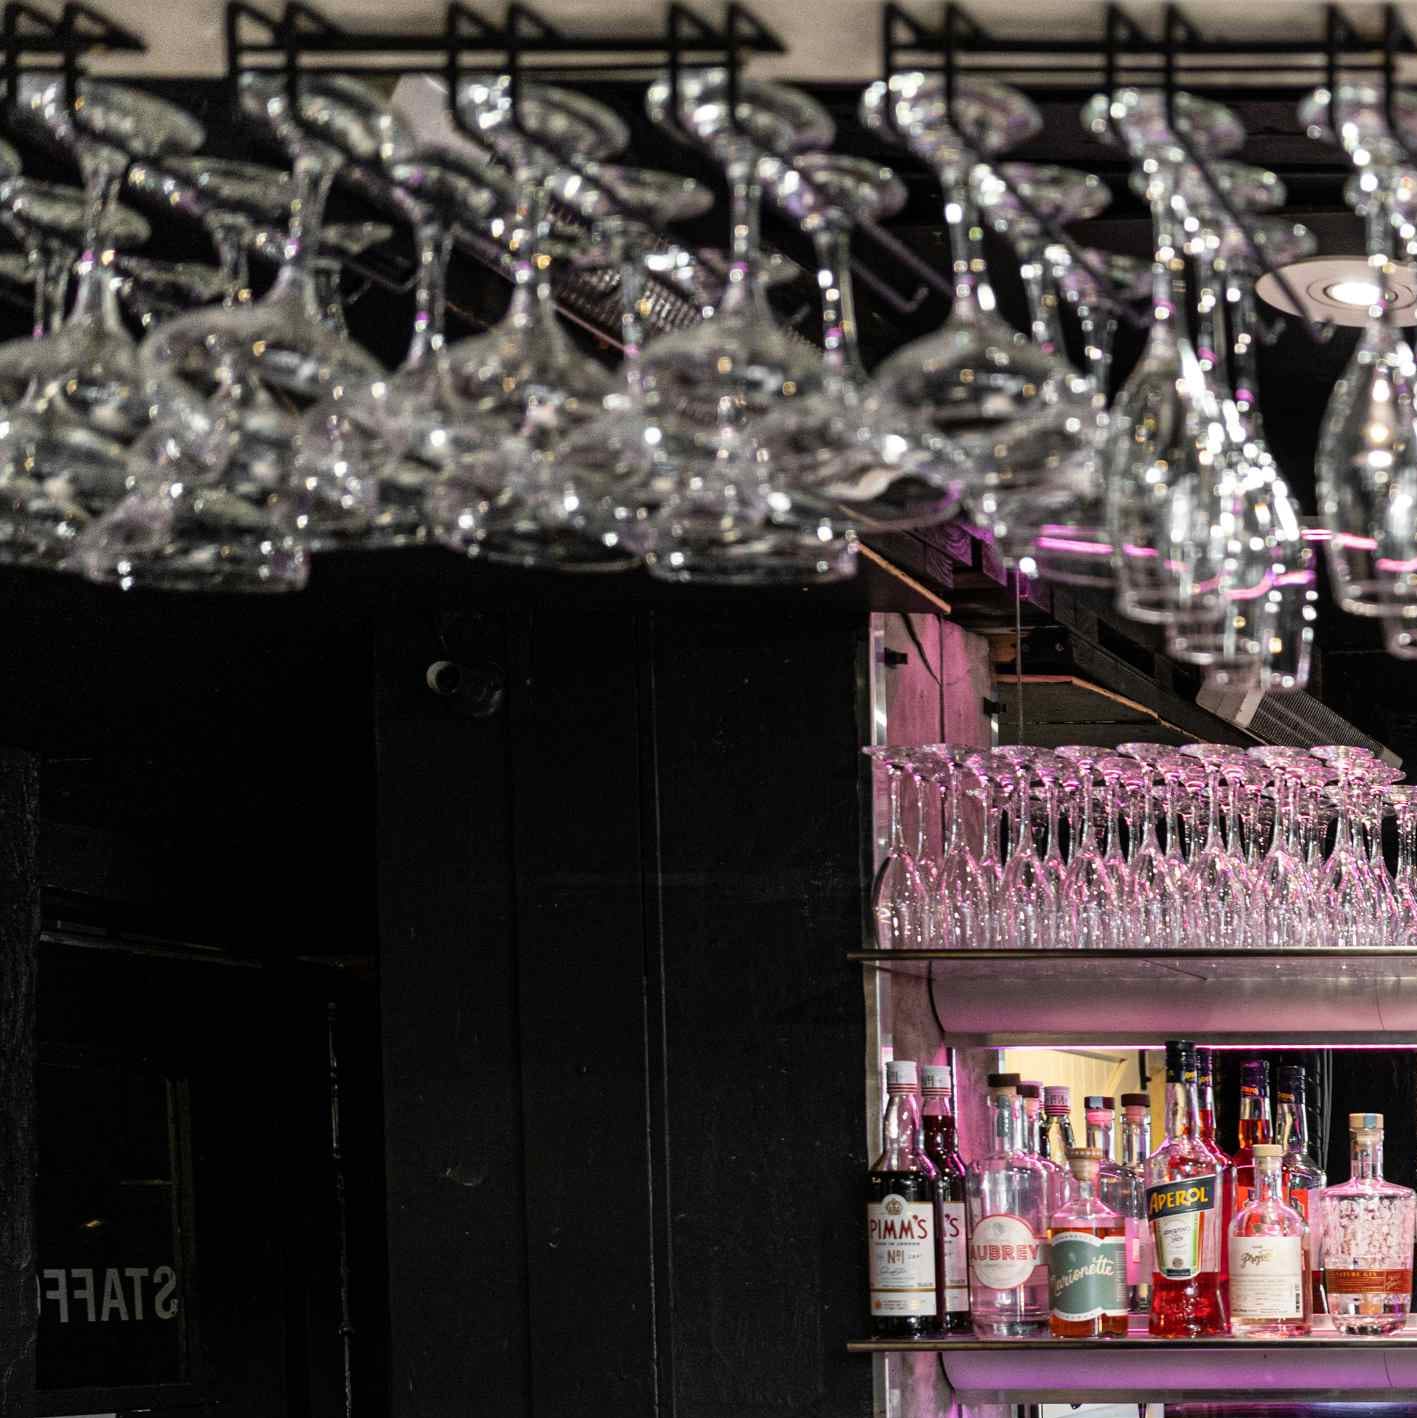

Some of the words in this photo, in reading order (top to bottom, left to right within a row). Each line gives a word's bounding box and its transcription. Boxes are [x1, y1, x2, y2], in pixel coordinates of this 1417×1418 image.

[1150, 1186, 1209, 1212] APEROL
[870, 1213, 928, 1239] PIMM'S
[970, 1243, 1040, 1261] AUBREY
